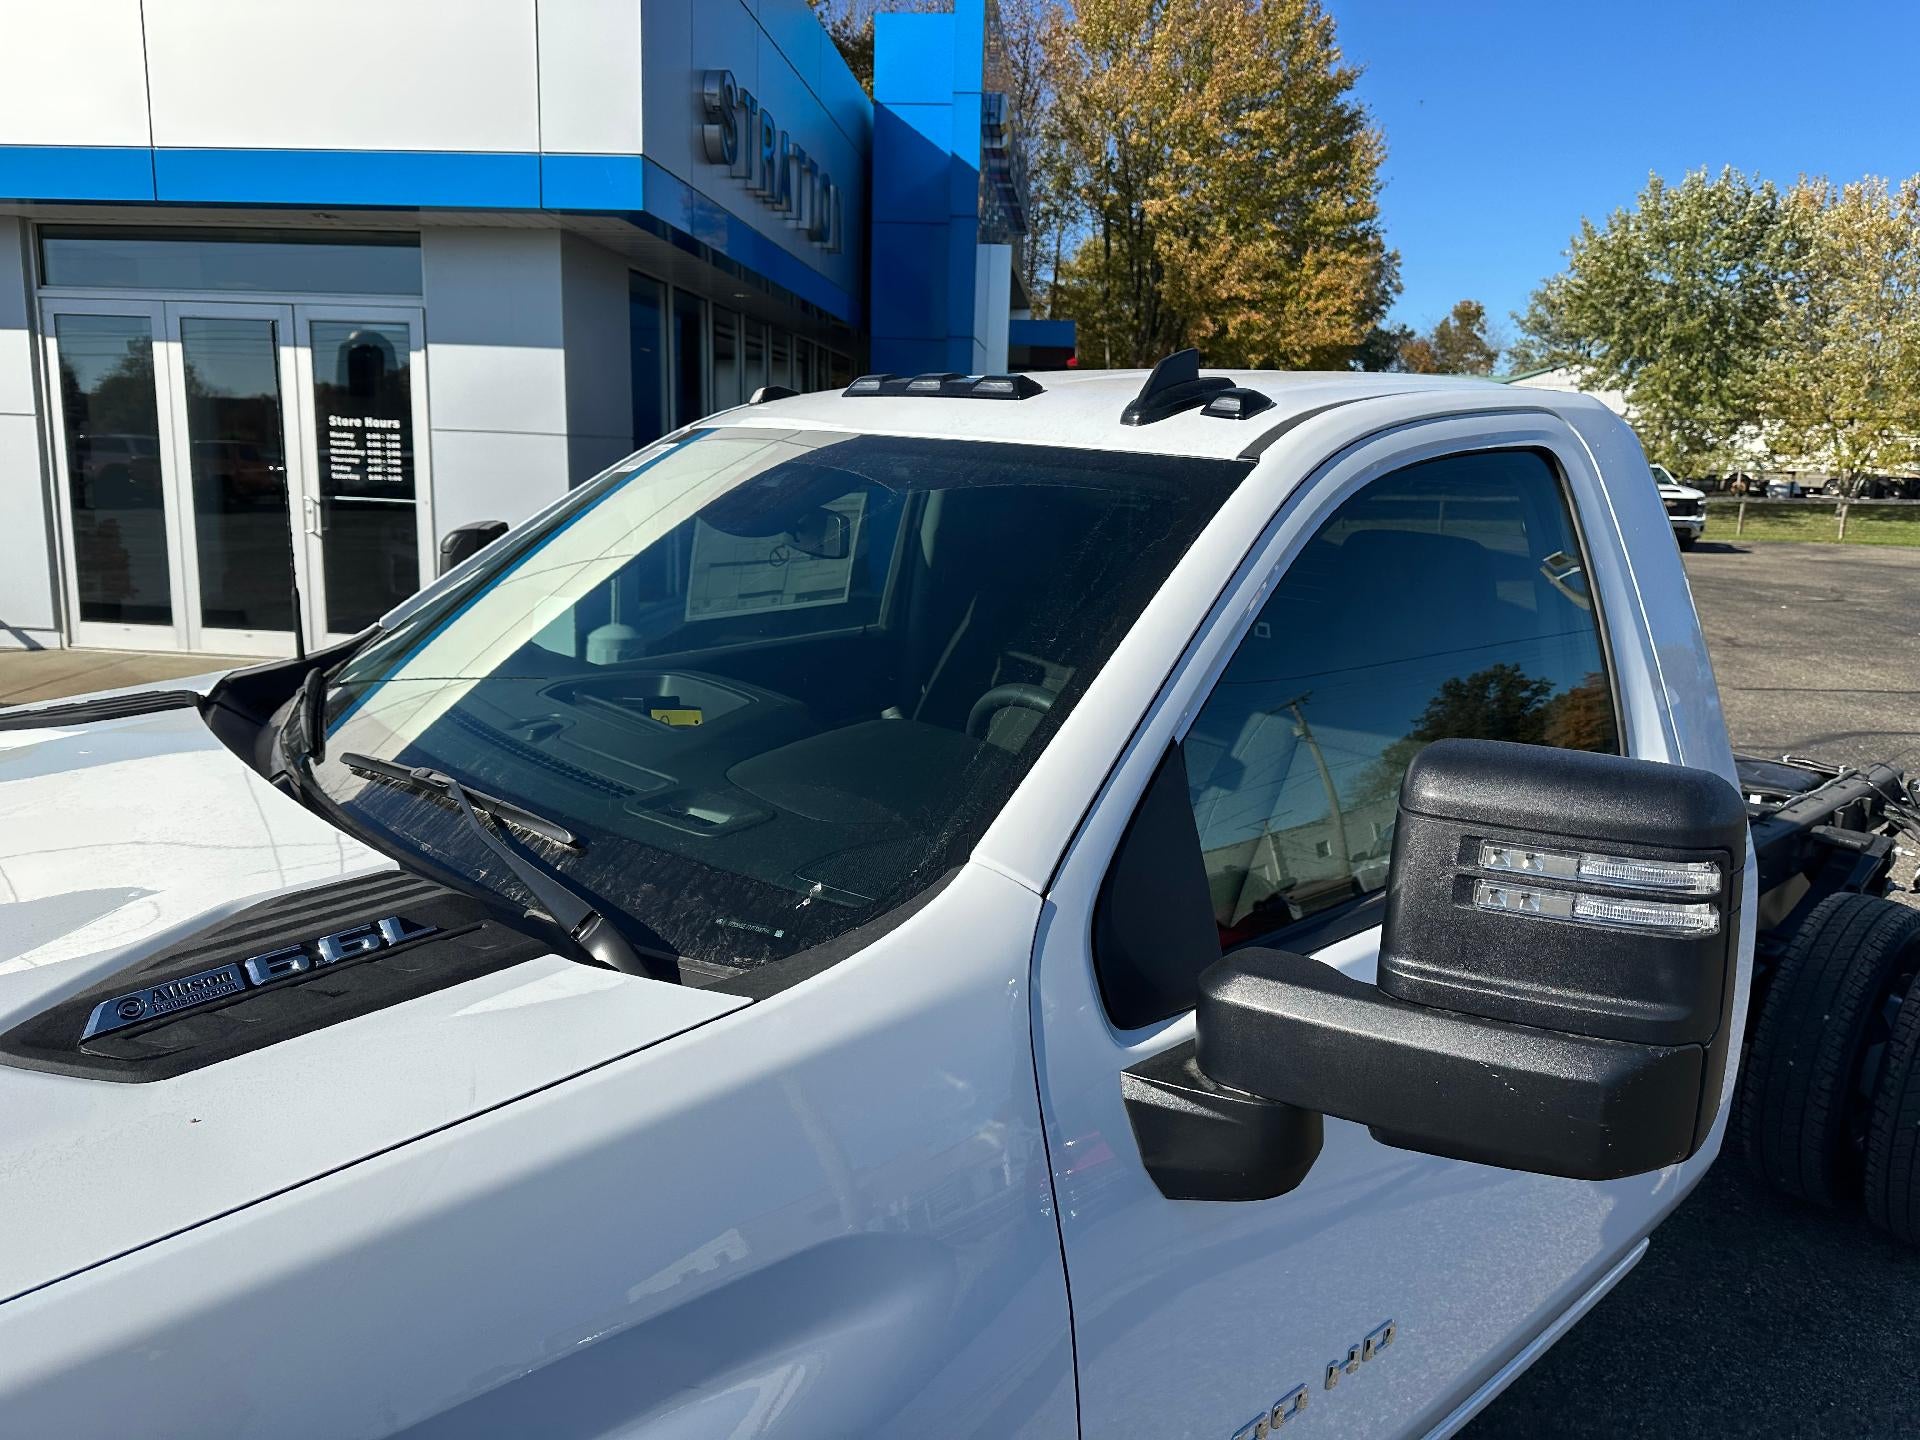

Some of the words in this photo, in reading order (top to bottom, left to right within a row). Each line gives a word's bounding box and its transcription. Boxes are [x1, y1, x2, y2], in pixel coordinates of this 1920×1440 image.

[328, 415, 362, 427] Store
[364, 417, 400, 429] Hours
[244, 916, 438, 986] 6.6L
[153, 971, 234, 1003] Allison
[1325, 1318, 1396, 1390] HD
